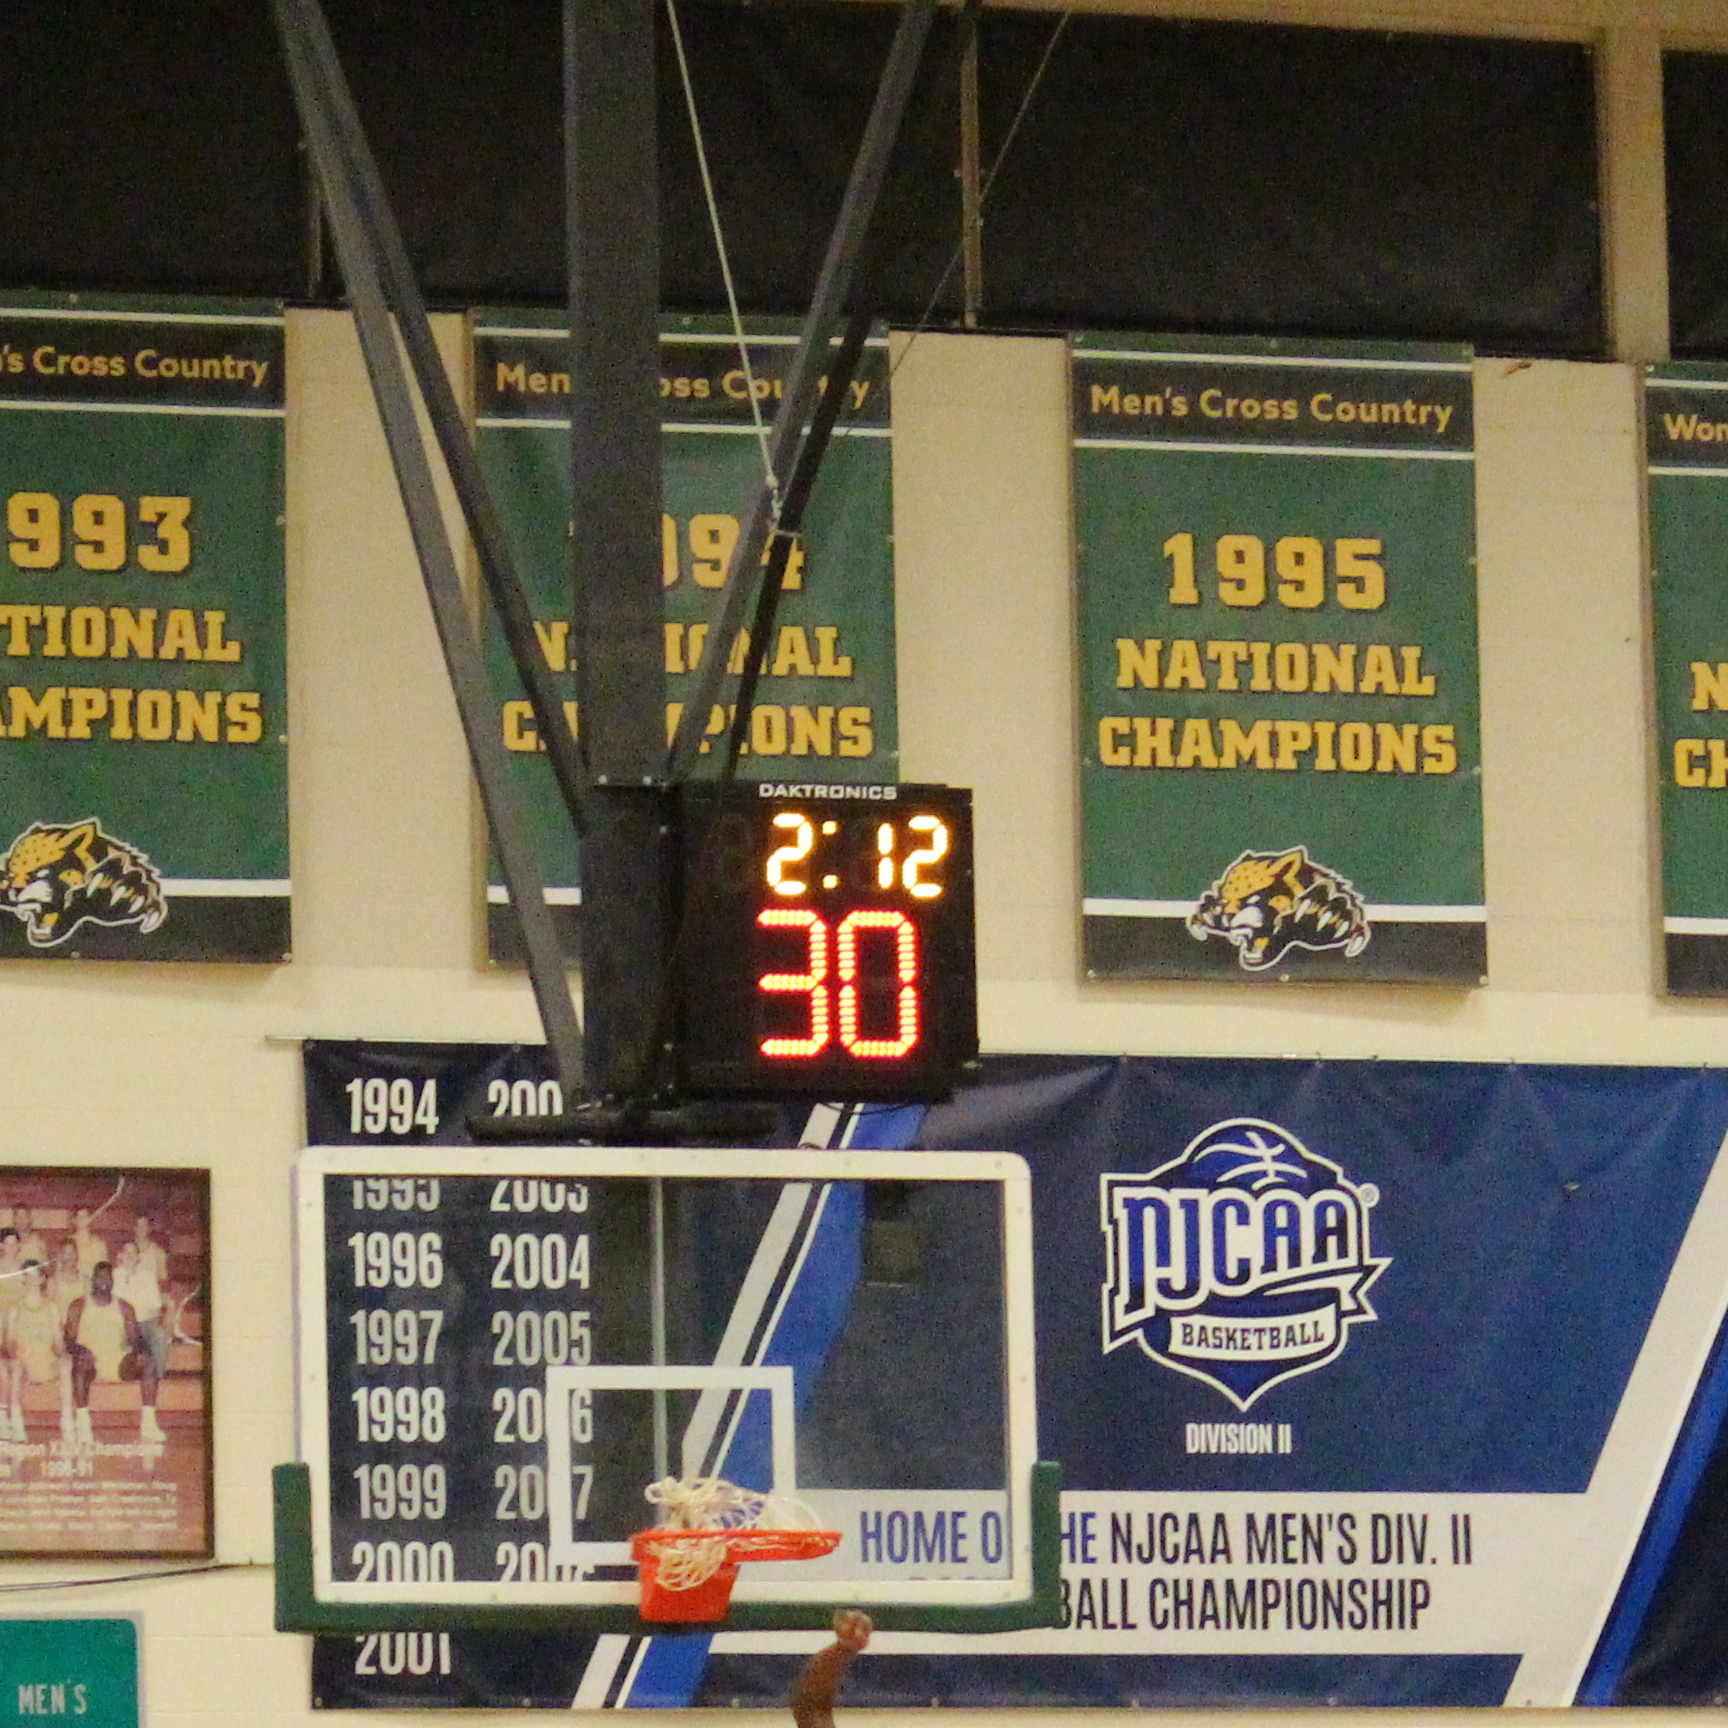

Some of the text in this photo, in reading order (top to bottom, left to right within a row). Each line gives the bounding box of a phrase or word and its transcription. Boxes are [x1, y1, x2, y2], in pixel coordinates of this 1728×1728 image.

[33, 346, 125, 377] Cross
[135, 349, 268, 388] Country
[1091, 385, 1453, 432] Men's Cross Country
[1163, 533, 1386, 610] 1995
[1116, 638, 1435, 696] NATIONAL
[1098, 717, 1457, 775] CHAMPIONS
[759, 783, 897, 800] DAKTRONICS
[766, 813, 948, 898] 2:12
[756, 909, 918, 1057] 30
[346, 1078, 439, 1134] 1994
[348, 1232, 444, 1288] 1996
[490, 1233, 590, 1290] 2004
[1123, 1196, 1348, 1315] NJCAA
[350, 1309, 444, 1365] 1997
[492, 1311, 591, 1366] 2005
[1181, 1321, 1324, 1350] BASKETBALL
[351, 1386, 446, 1442] 1998
[493, 1387, 593, 1443] 206
[1186, 1423, 1291, 1453] DIVISION II
[353, 1464, 447, 1520] 1999
[494, 1465, 593, 1520] 207
[352, 1541, 454, 1582] 2000
[861, 1511, 967, 1564] HOME
[1059, 1512, 1097, 1564] HE
[1111, 1512, 1232, 1564] NJCAA
[1246, 1512, 1357, 1564] MEN'S
[1372, 1512, 1437, 1564] DIV.
[1452, 1513, 1471, 1564] II
[1150, 1578, 1430, 1630] CHAMPIONSHIP
[355, 1632, 451, 1675] 2001
